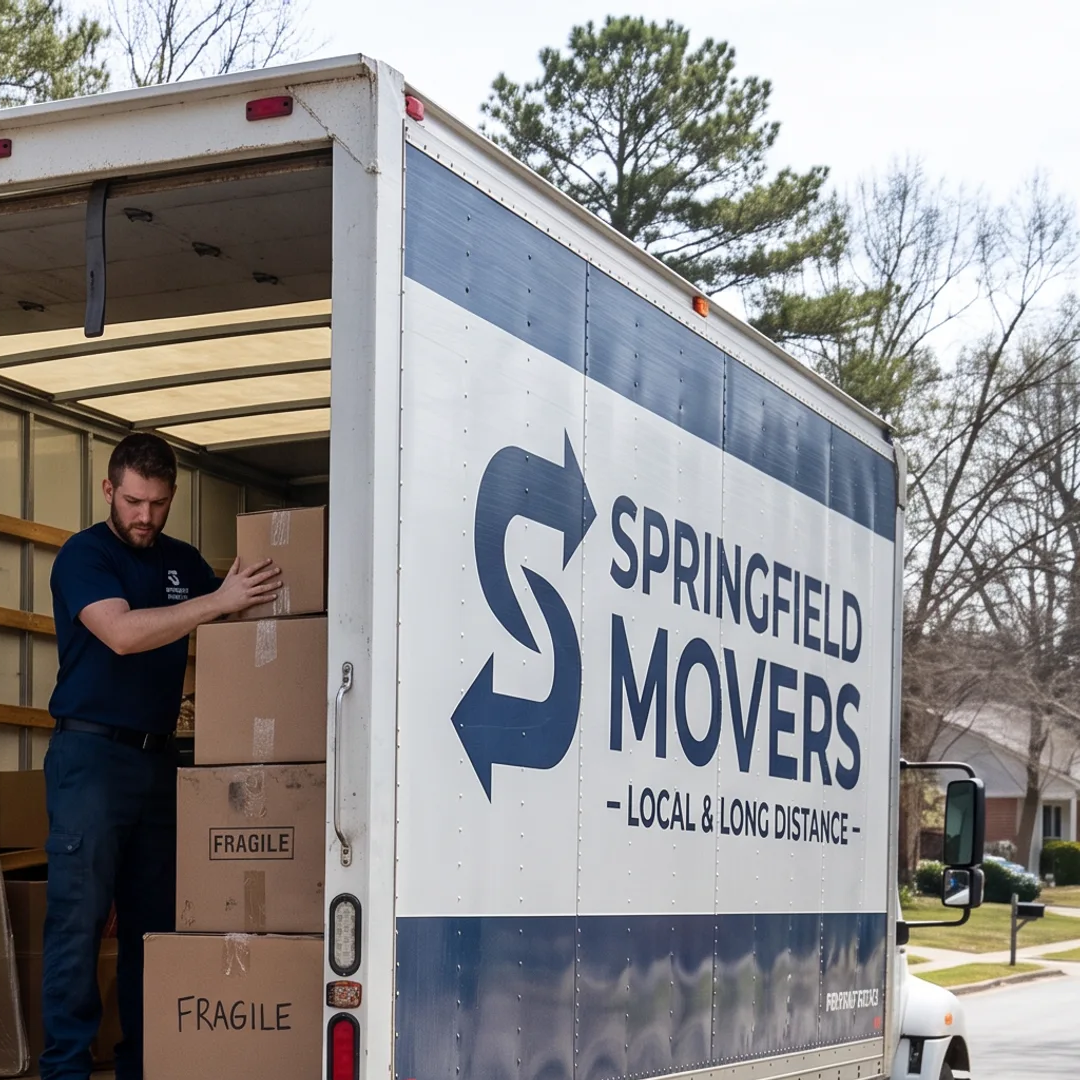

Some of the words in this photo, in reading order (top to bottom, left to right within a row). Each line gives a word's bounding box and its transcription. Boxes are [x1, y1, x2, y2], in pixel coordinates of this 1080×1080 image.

[609, 495, 862, 664] SPRINGFIELD
[609, 613, 861, 791] MOVERS
[214, 834, 290, 853] FRAGILE
[627, 784, 696, 832] LOCAL
[701, 794, 714, 834] &
[720, 797, 769, 838] LONG
[774, 804, 849, 845] DISTANCE
[177, 995, 292, 1033] FRAGILE
